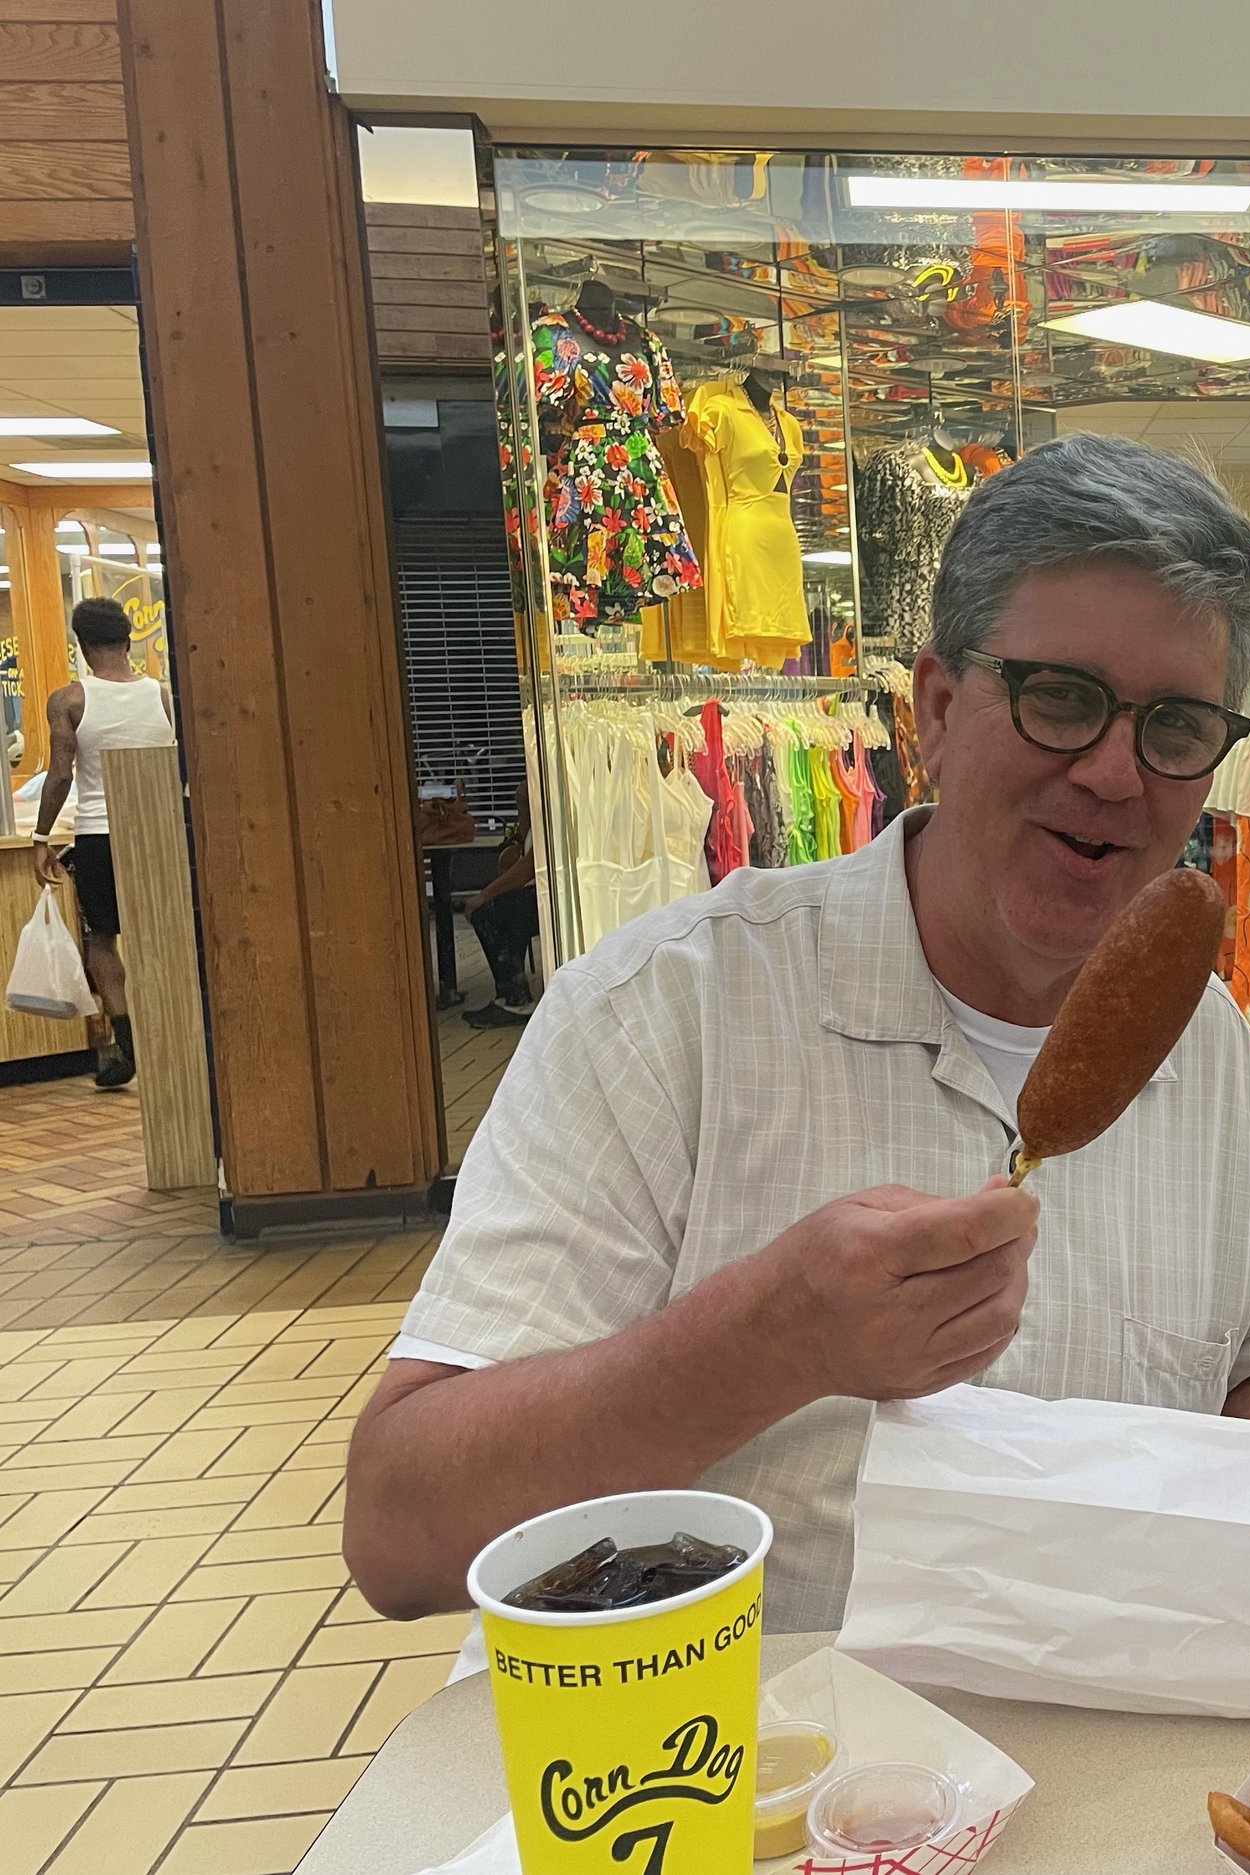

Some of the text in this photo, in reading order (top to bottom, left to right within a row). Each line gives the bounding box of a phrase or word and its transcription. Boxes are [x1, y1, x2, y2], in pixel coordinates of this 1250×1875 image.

[0, 636, 19, 665] ESE
[494, 1592, 762, 1688] BETTER THAN GOOD
[541, 1714, 744, 1842] Corn Dog
